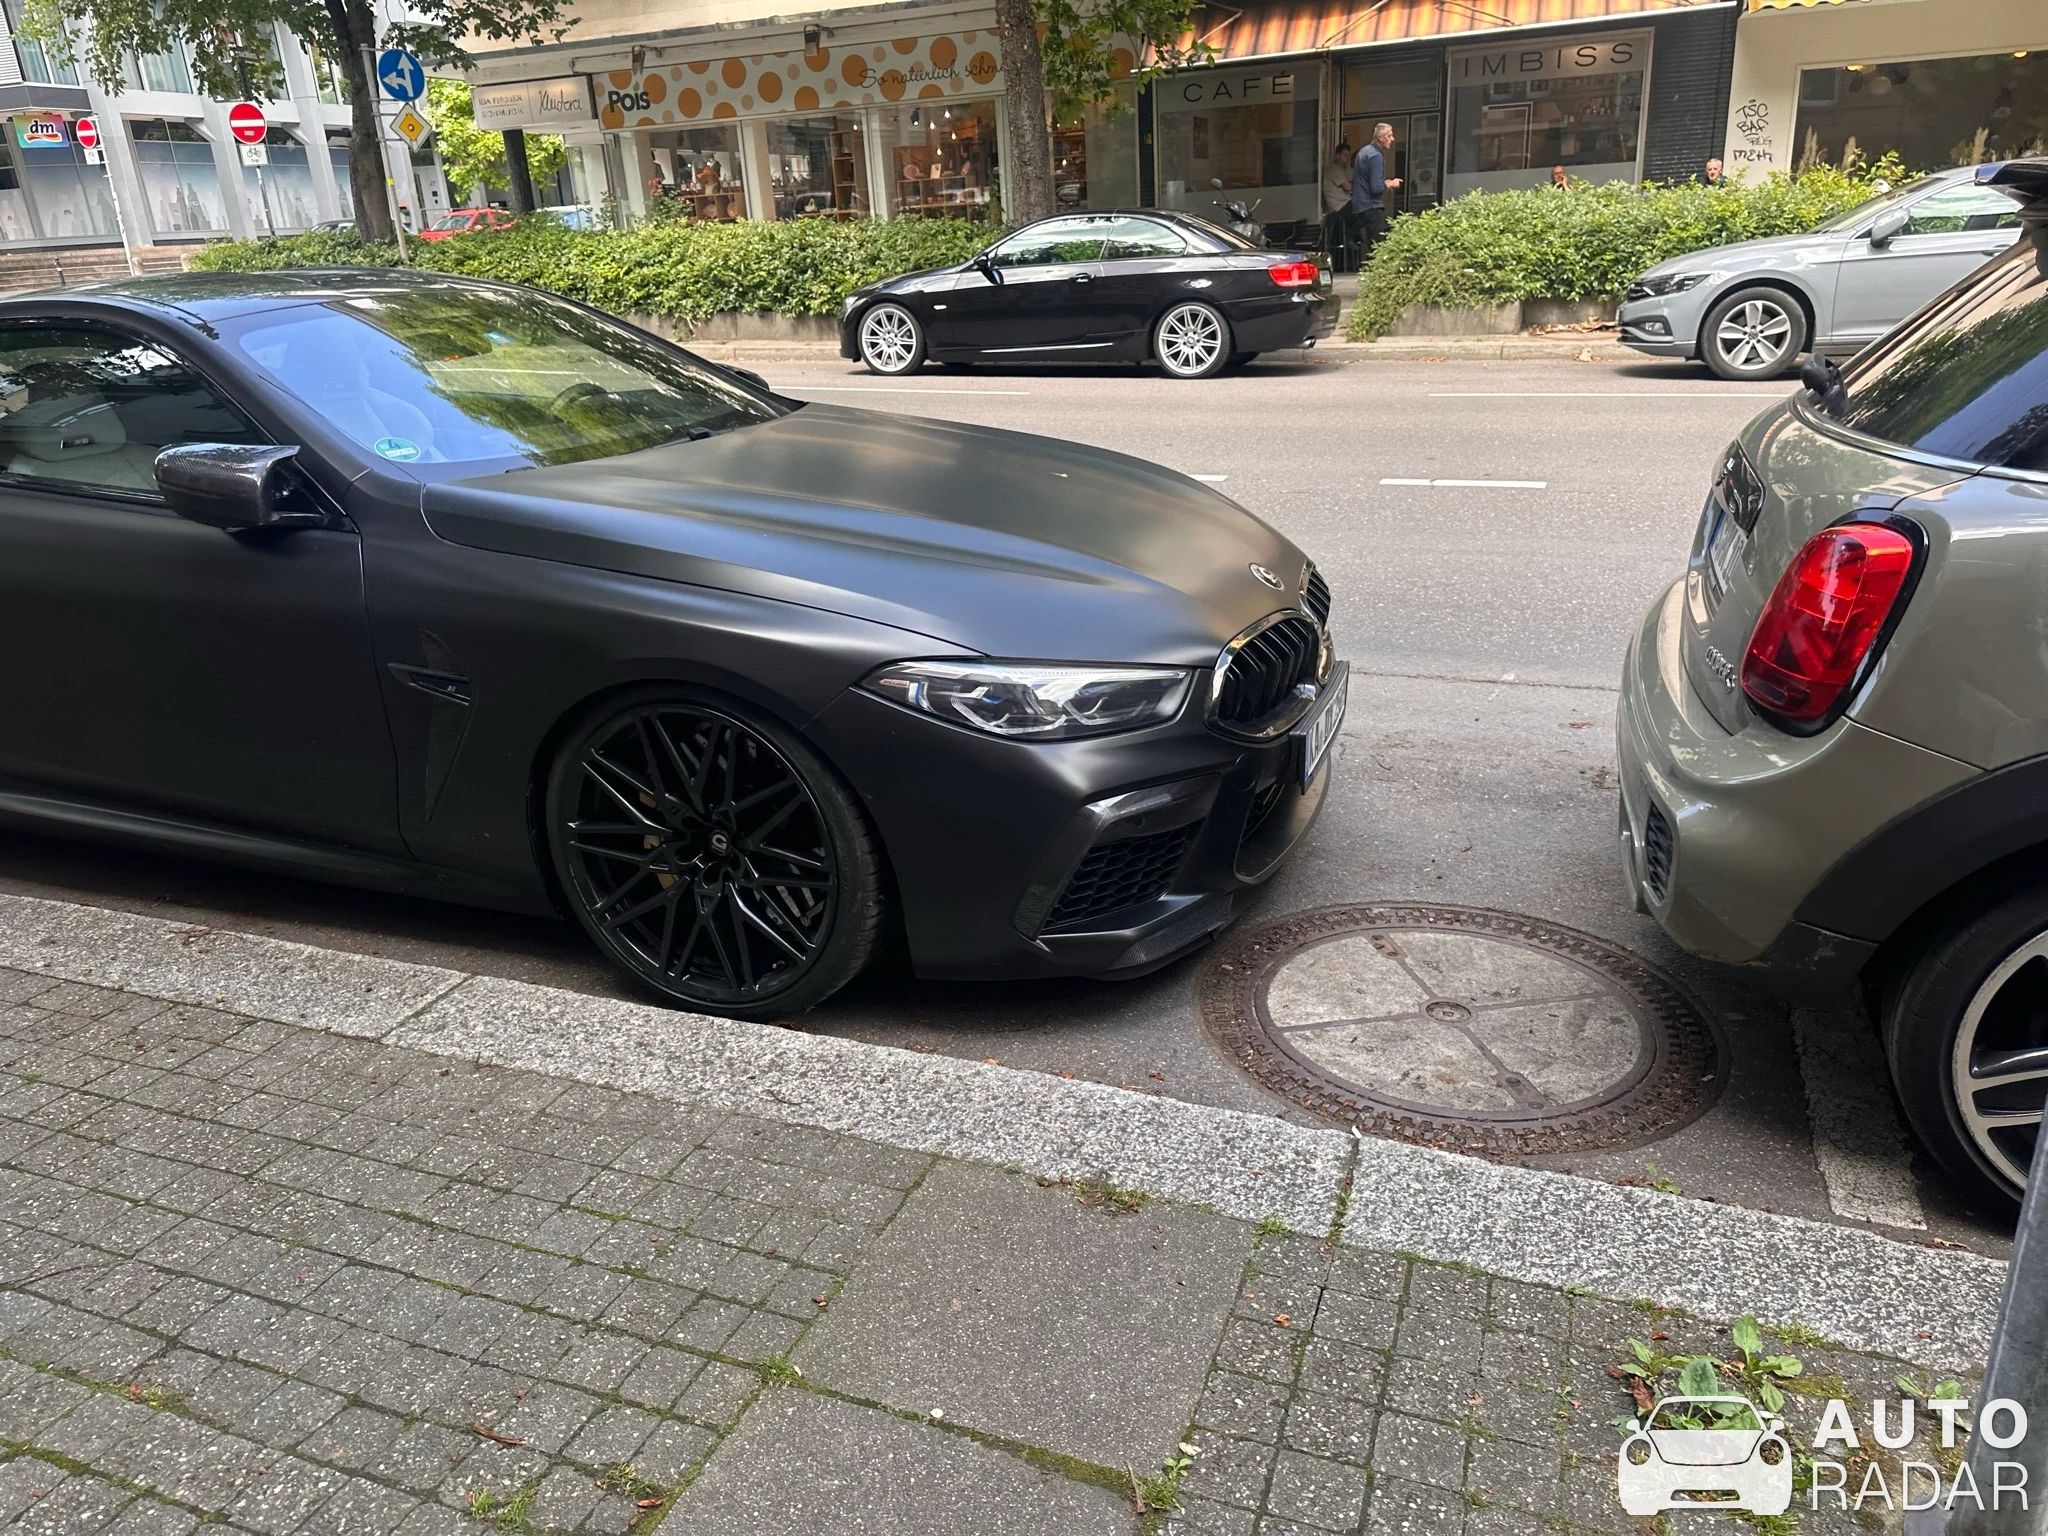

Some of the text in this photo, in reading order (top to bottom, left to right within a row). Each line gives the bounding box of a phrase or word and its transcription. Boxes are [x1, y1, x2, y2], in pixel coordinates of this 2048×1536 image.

[860, 55, 1004, 89] So natürlich schm
[1464, 43, 1633, 78] IMBISS
[1183, 70, 1292, 102] CAFÉ
[29, 119, 55, 134] dm
